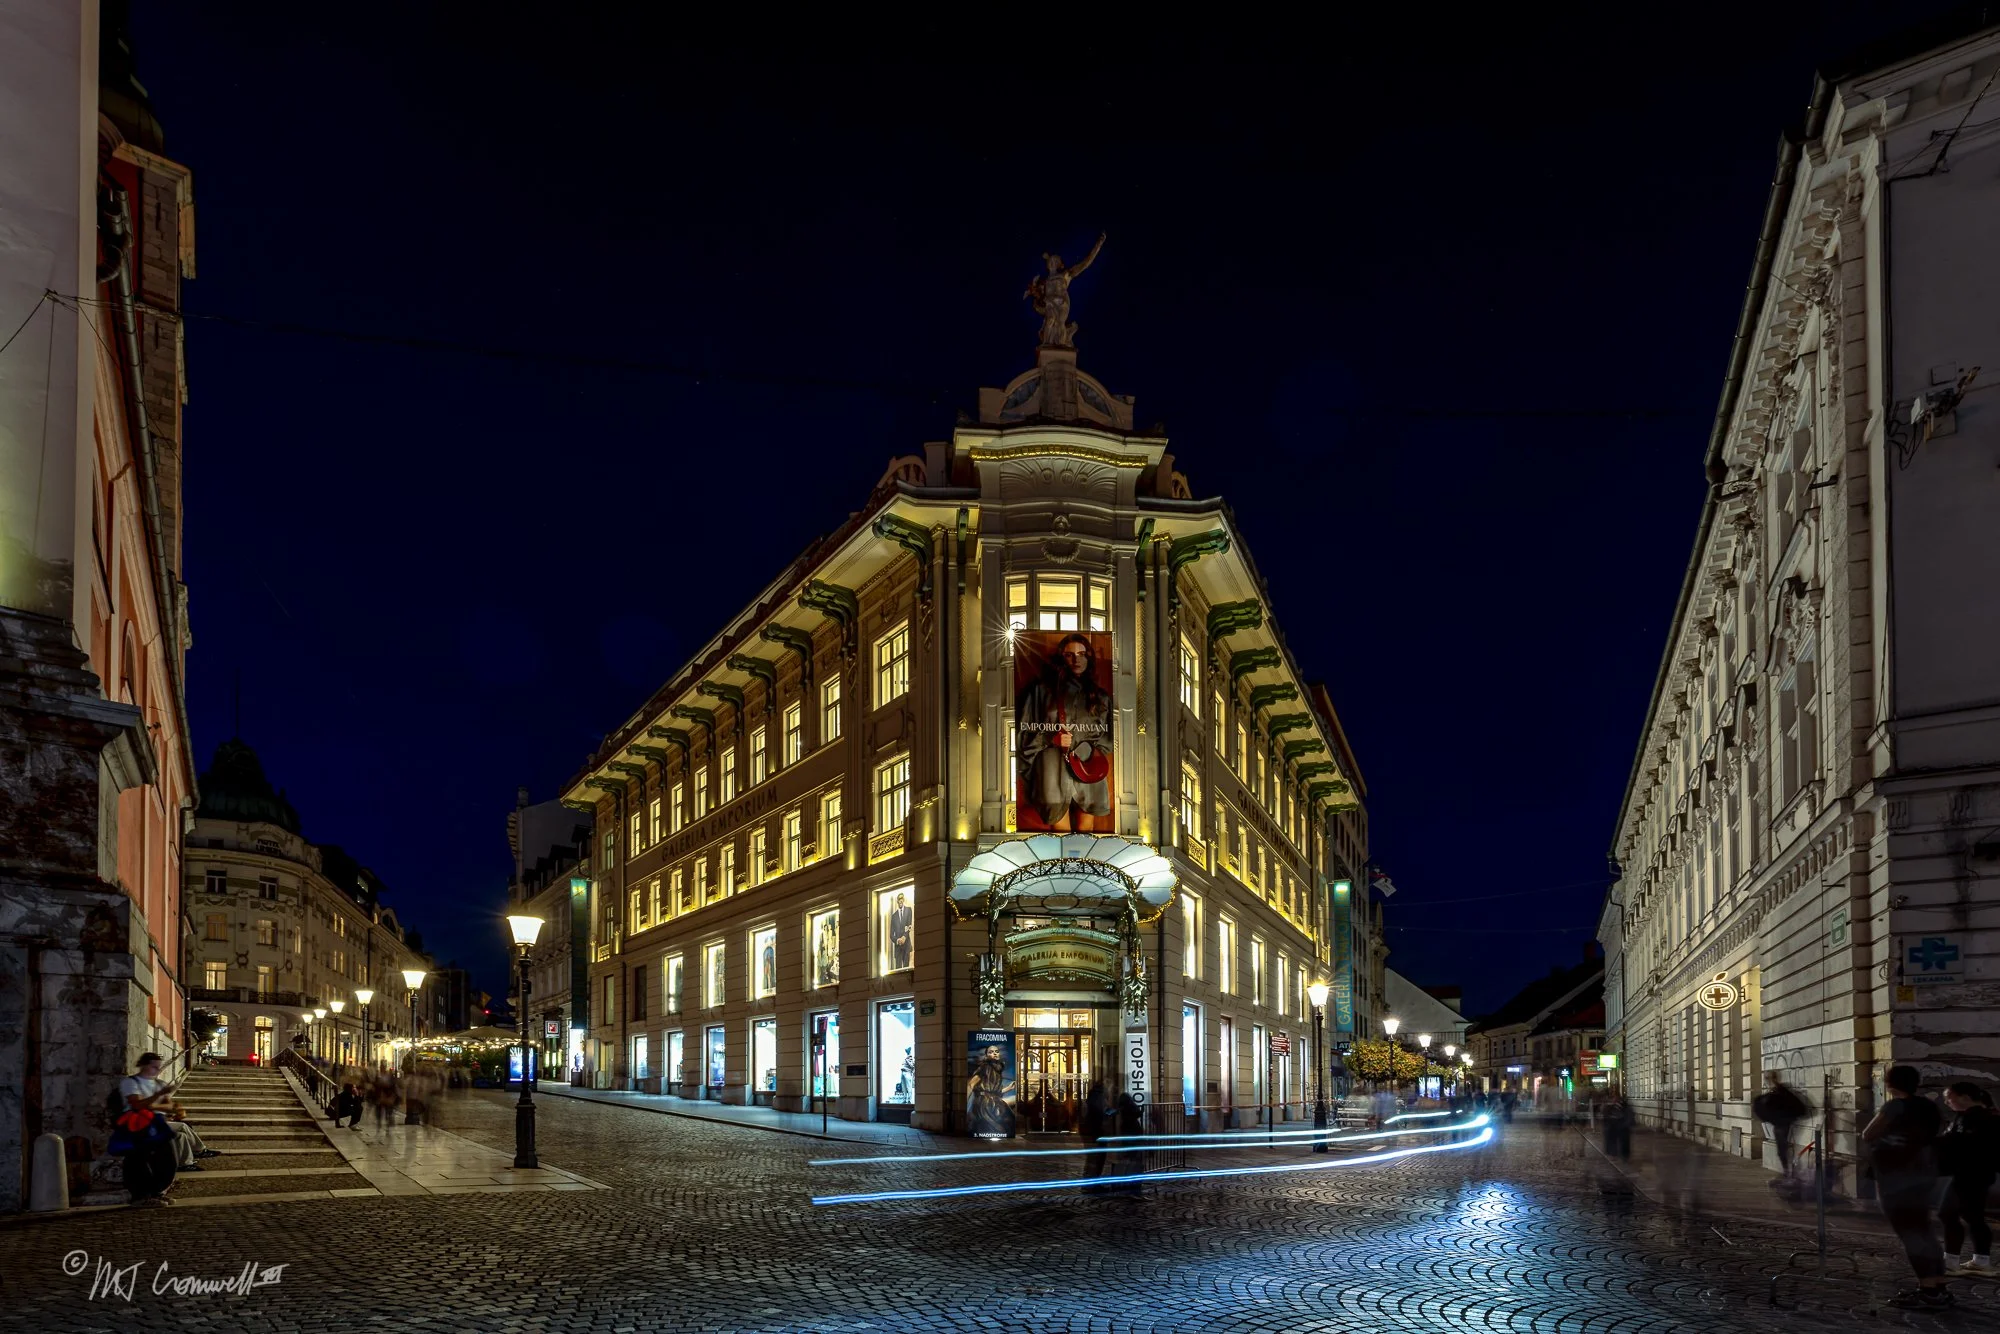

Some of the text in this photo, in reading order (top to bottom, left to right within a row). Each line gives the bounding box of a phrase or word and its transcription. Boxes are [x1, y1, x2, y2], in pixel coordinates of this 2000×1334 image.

[1020, 722, 1108, 732] EMPORIO ARMANI
[711, 785, 778, 836] EMPORIUM
[1020, 950, 1105, 965] GALERIJA EMPORIUM
[976, 1033, 1008, 1042] FRACOMINA
